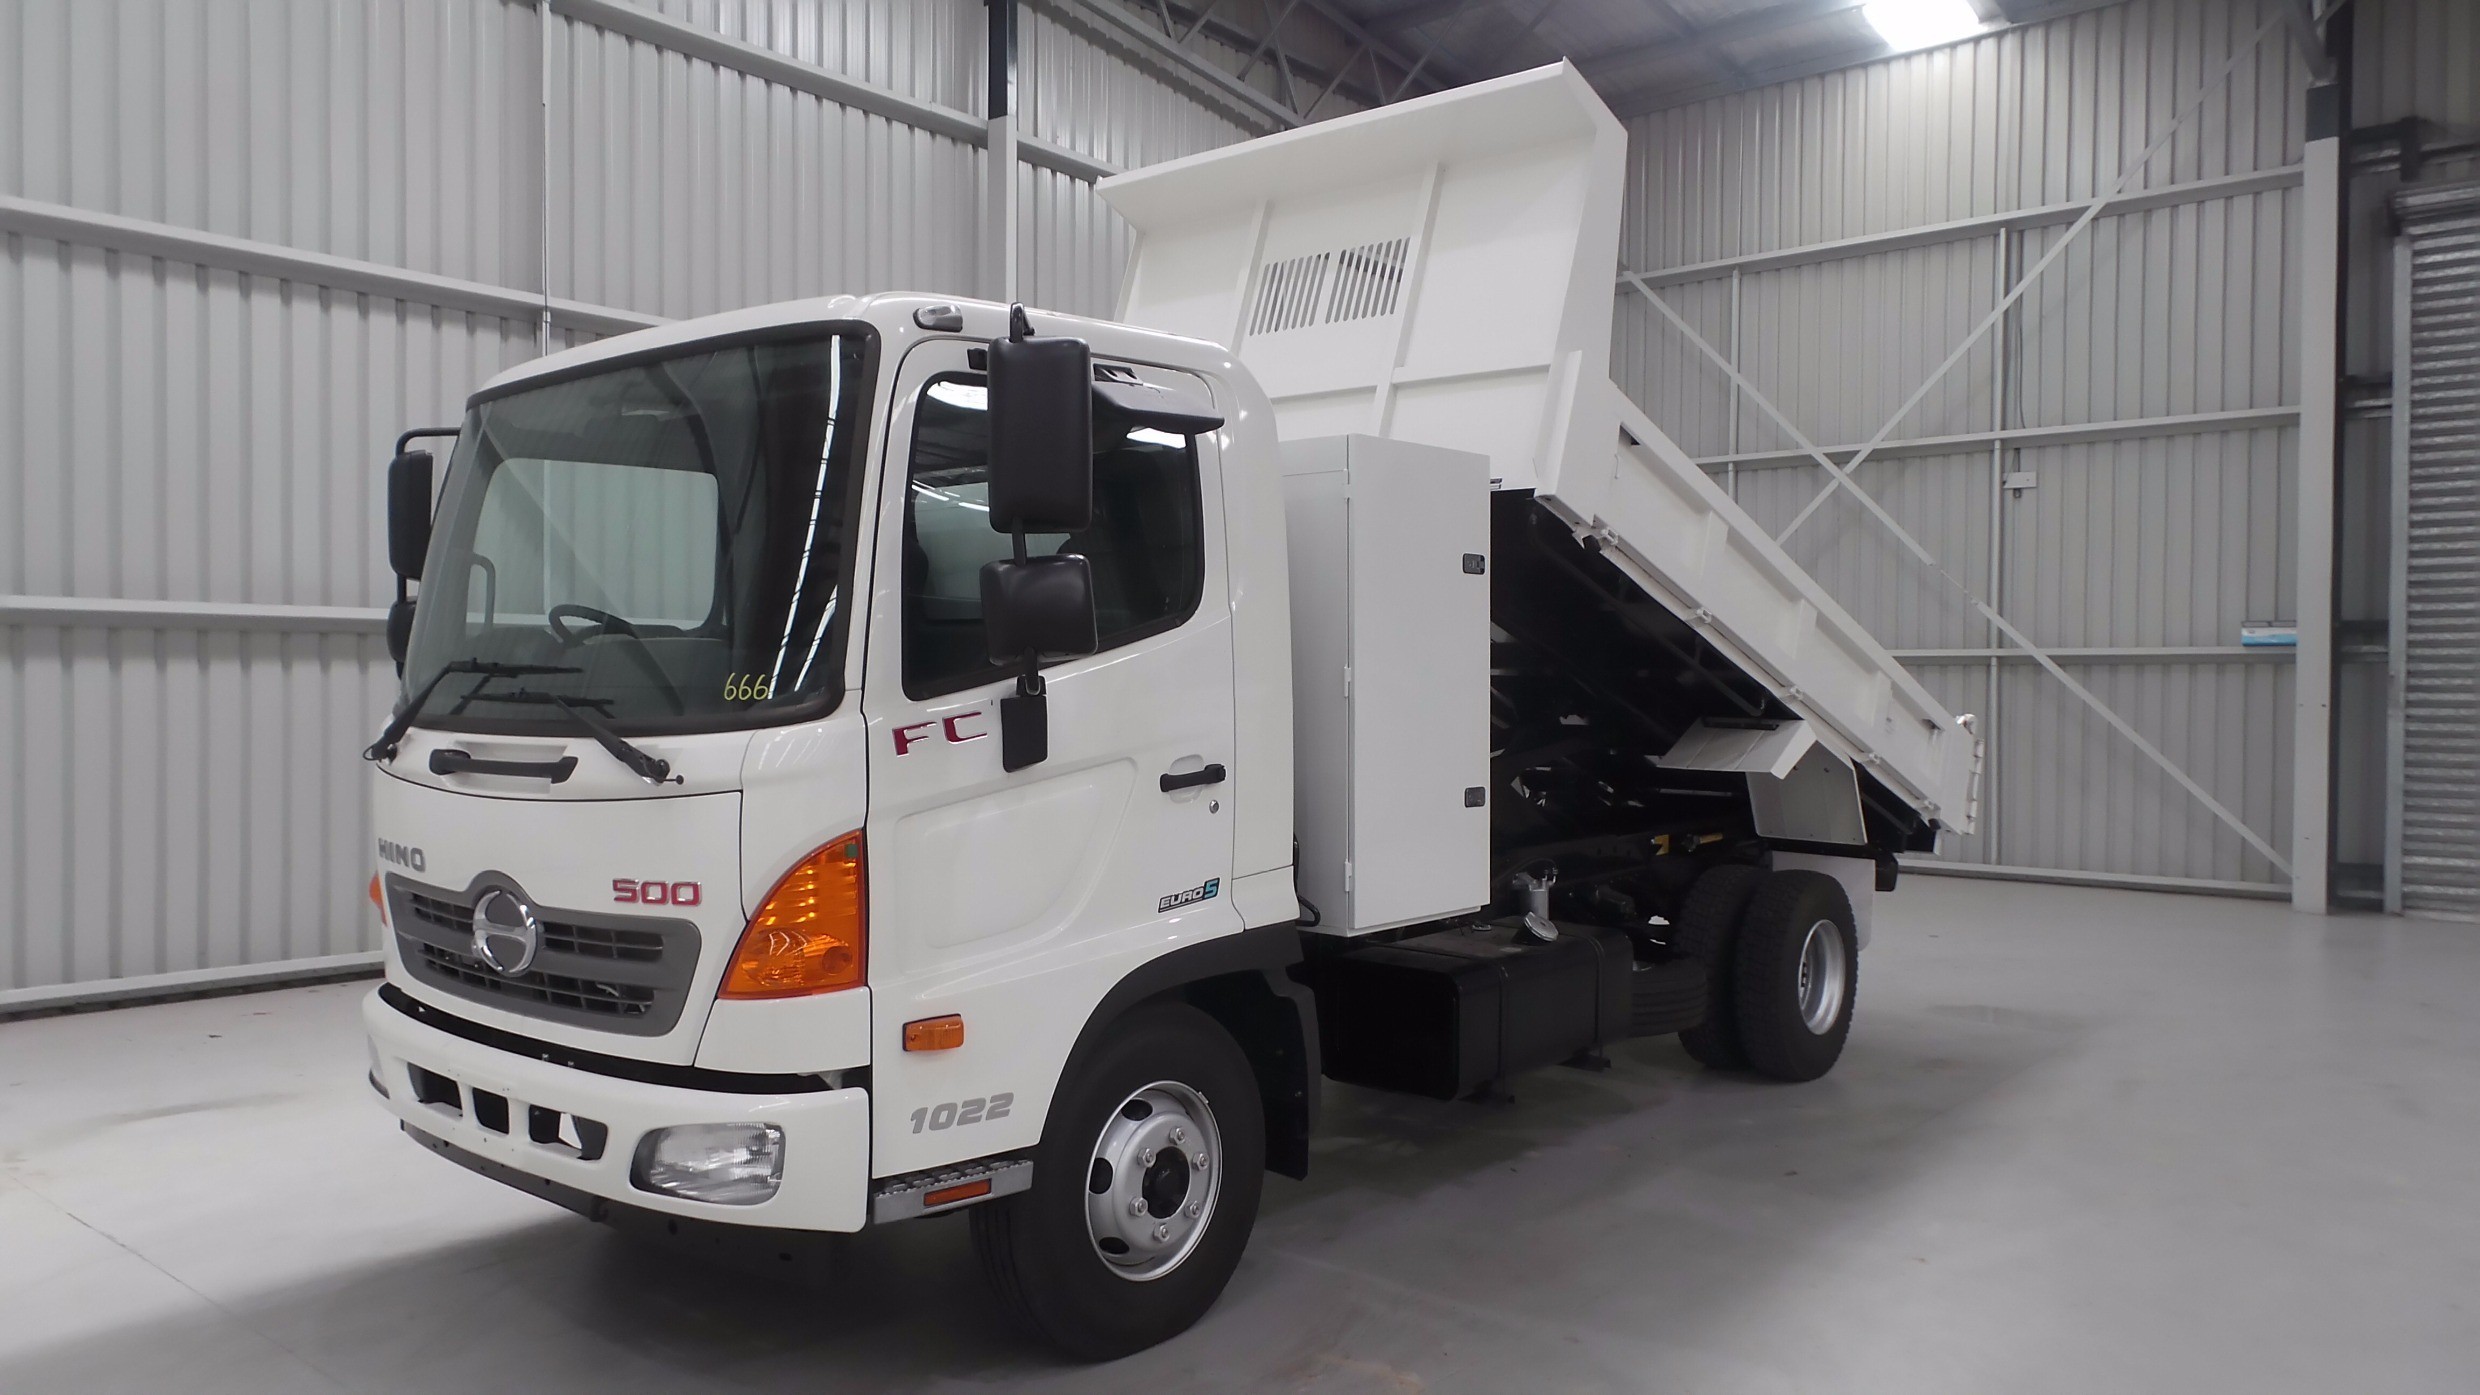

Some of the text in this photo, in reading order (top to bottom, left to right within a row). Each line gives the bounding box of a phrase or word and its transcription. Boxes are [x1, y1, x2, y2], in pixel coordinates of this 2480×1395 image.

[724, 672, 769, 701] 666
[892, 711, 988, 757] FC
[378, 837, 426, 873] HINO
[612, 878, 702, 906] 500
[910, 1092, 1014, 1134] 1022
